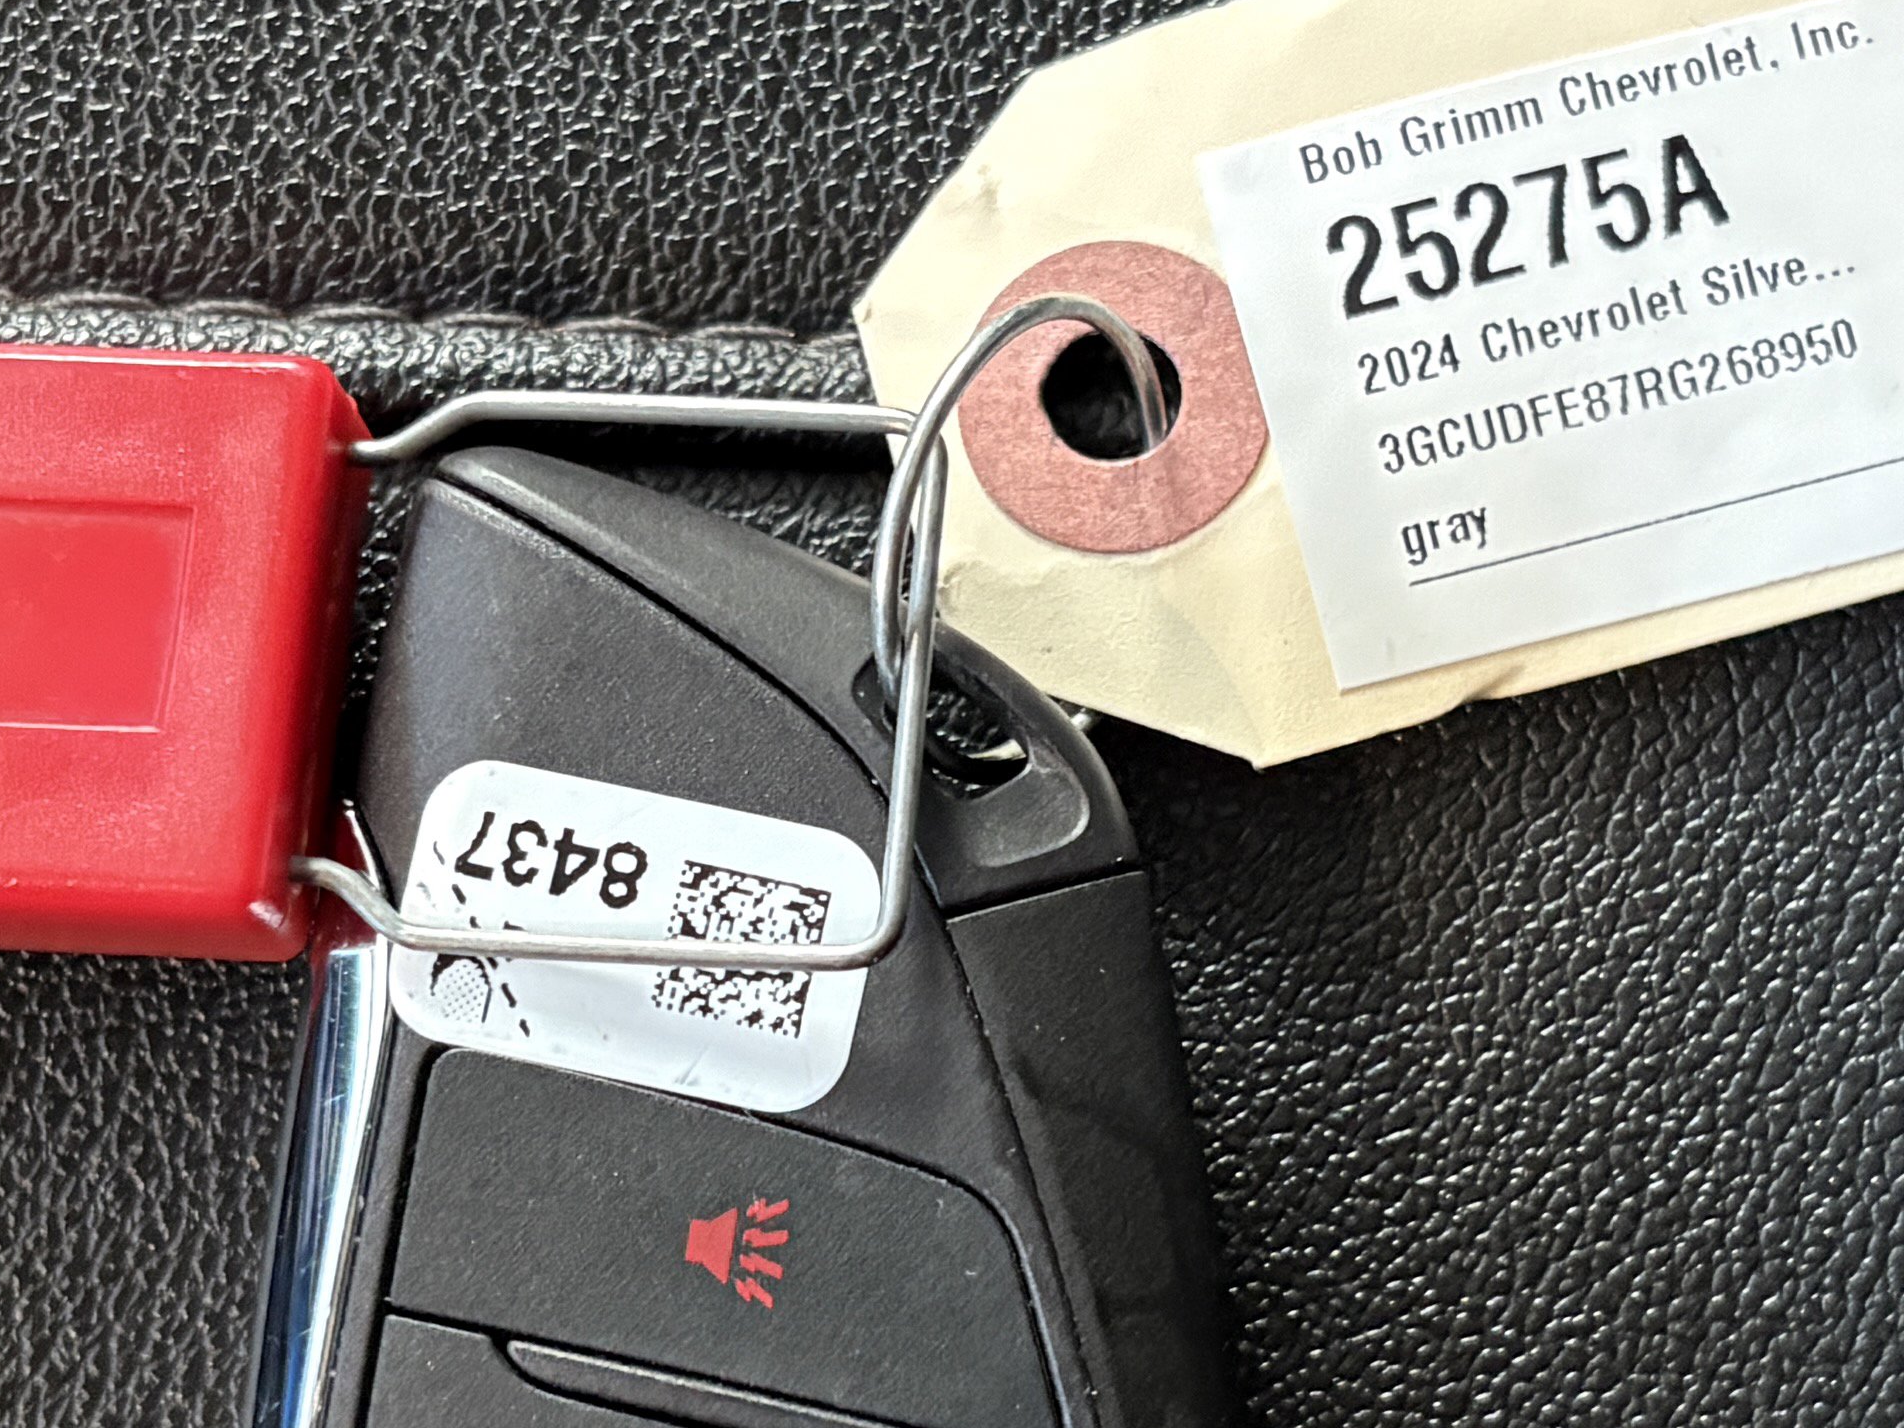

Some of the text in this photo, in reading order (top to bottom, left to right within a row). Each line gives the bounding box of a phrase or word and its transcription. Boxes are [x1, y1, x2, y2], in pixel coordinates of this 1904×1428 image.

[1298, 130, 1384, 184] Bob
[1398, 92, 1544, 158] Grimm
[1790, 21, 1875, 60] Inc.
[1325, 134, 1731, 320] 25275A
[1357, 256, 1856, 395] 2024 Chevrolet Silve...
[1377, 318, 1859, 474] 3GCUDFE87RG268950
[1400, 505, 1488, 566] gray
[454, 810, 649, 910] 8437
